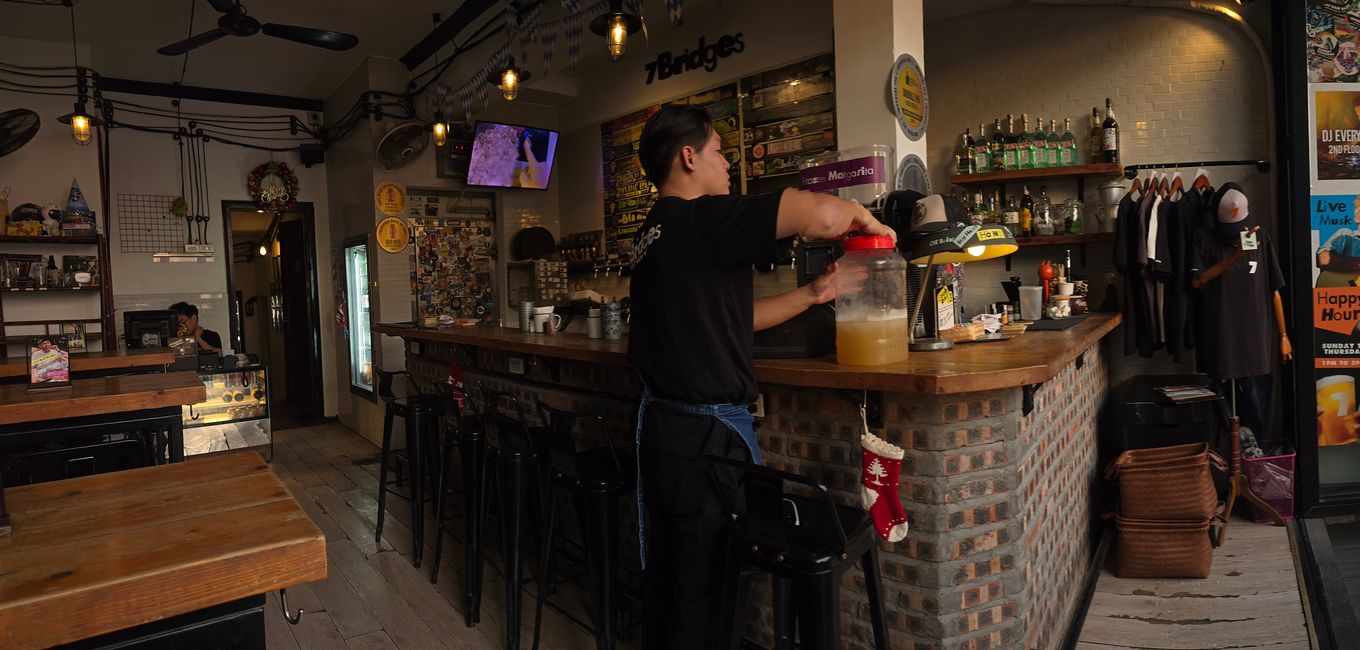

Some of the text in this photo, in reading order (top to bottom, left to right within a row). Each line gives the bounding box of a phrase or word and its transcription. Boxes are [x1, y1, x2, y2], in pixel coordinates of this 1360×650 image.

[1321, 129, 1333, 142] DJ
[1335, 129, 1360, 142] EVERY
[1328, 144, 1343, 154] 2ND
[828, 166, 874, 181] Margarita
[1317, 199, 1347, 213] Live
[1320, 215, 1352, 226] Music
[1248, 261, 1258, 274] 7
[1321, 308, 1360, 321] Hour
[1331, 392, 1349, 417] 7
